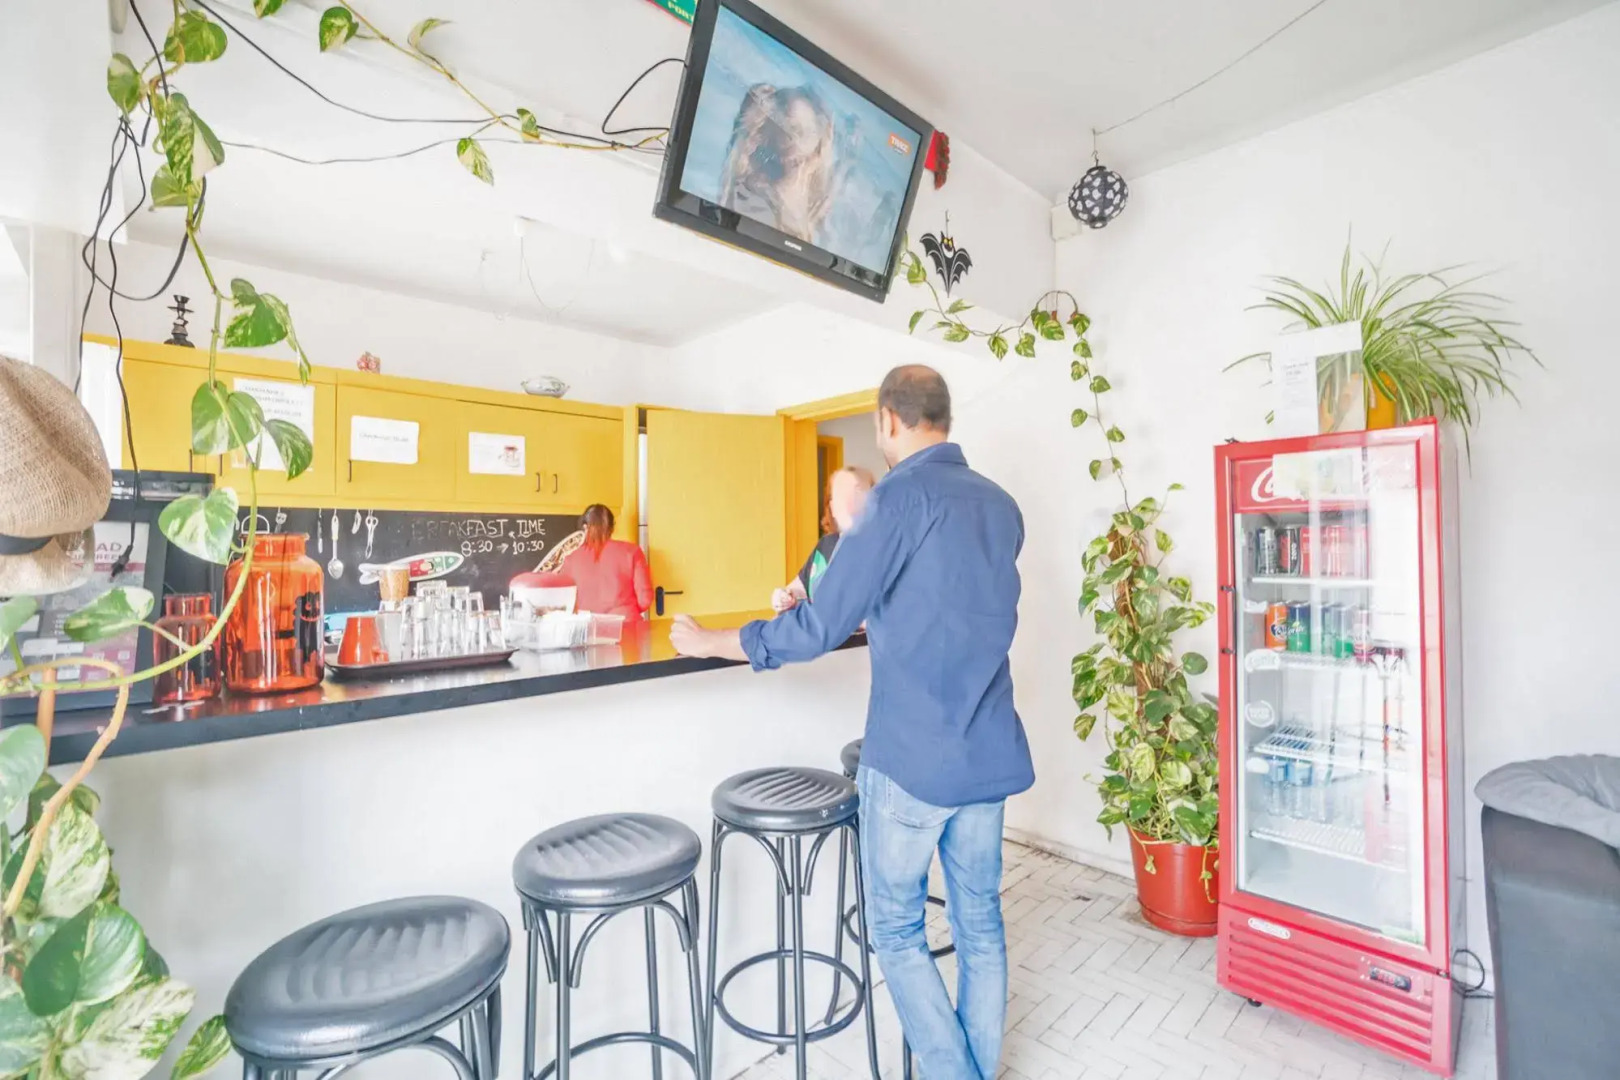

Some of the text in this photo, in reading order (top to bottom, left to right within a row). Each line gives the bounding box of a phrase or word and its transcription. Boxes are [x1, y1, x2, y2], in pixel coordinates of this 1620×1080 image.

[517, 519, 546, 538] TIME
[461, 540, 544, 557] 8:30 10:30
